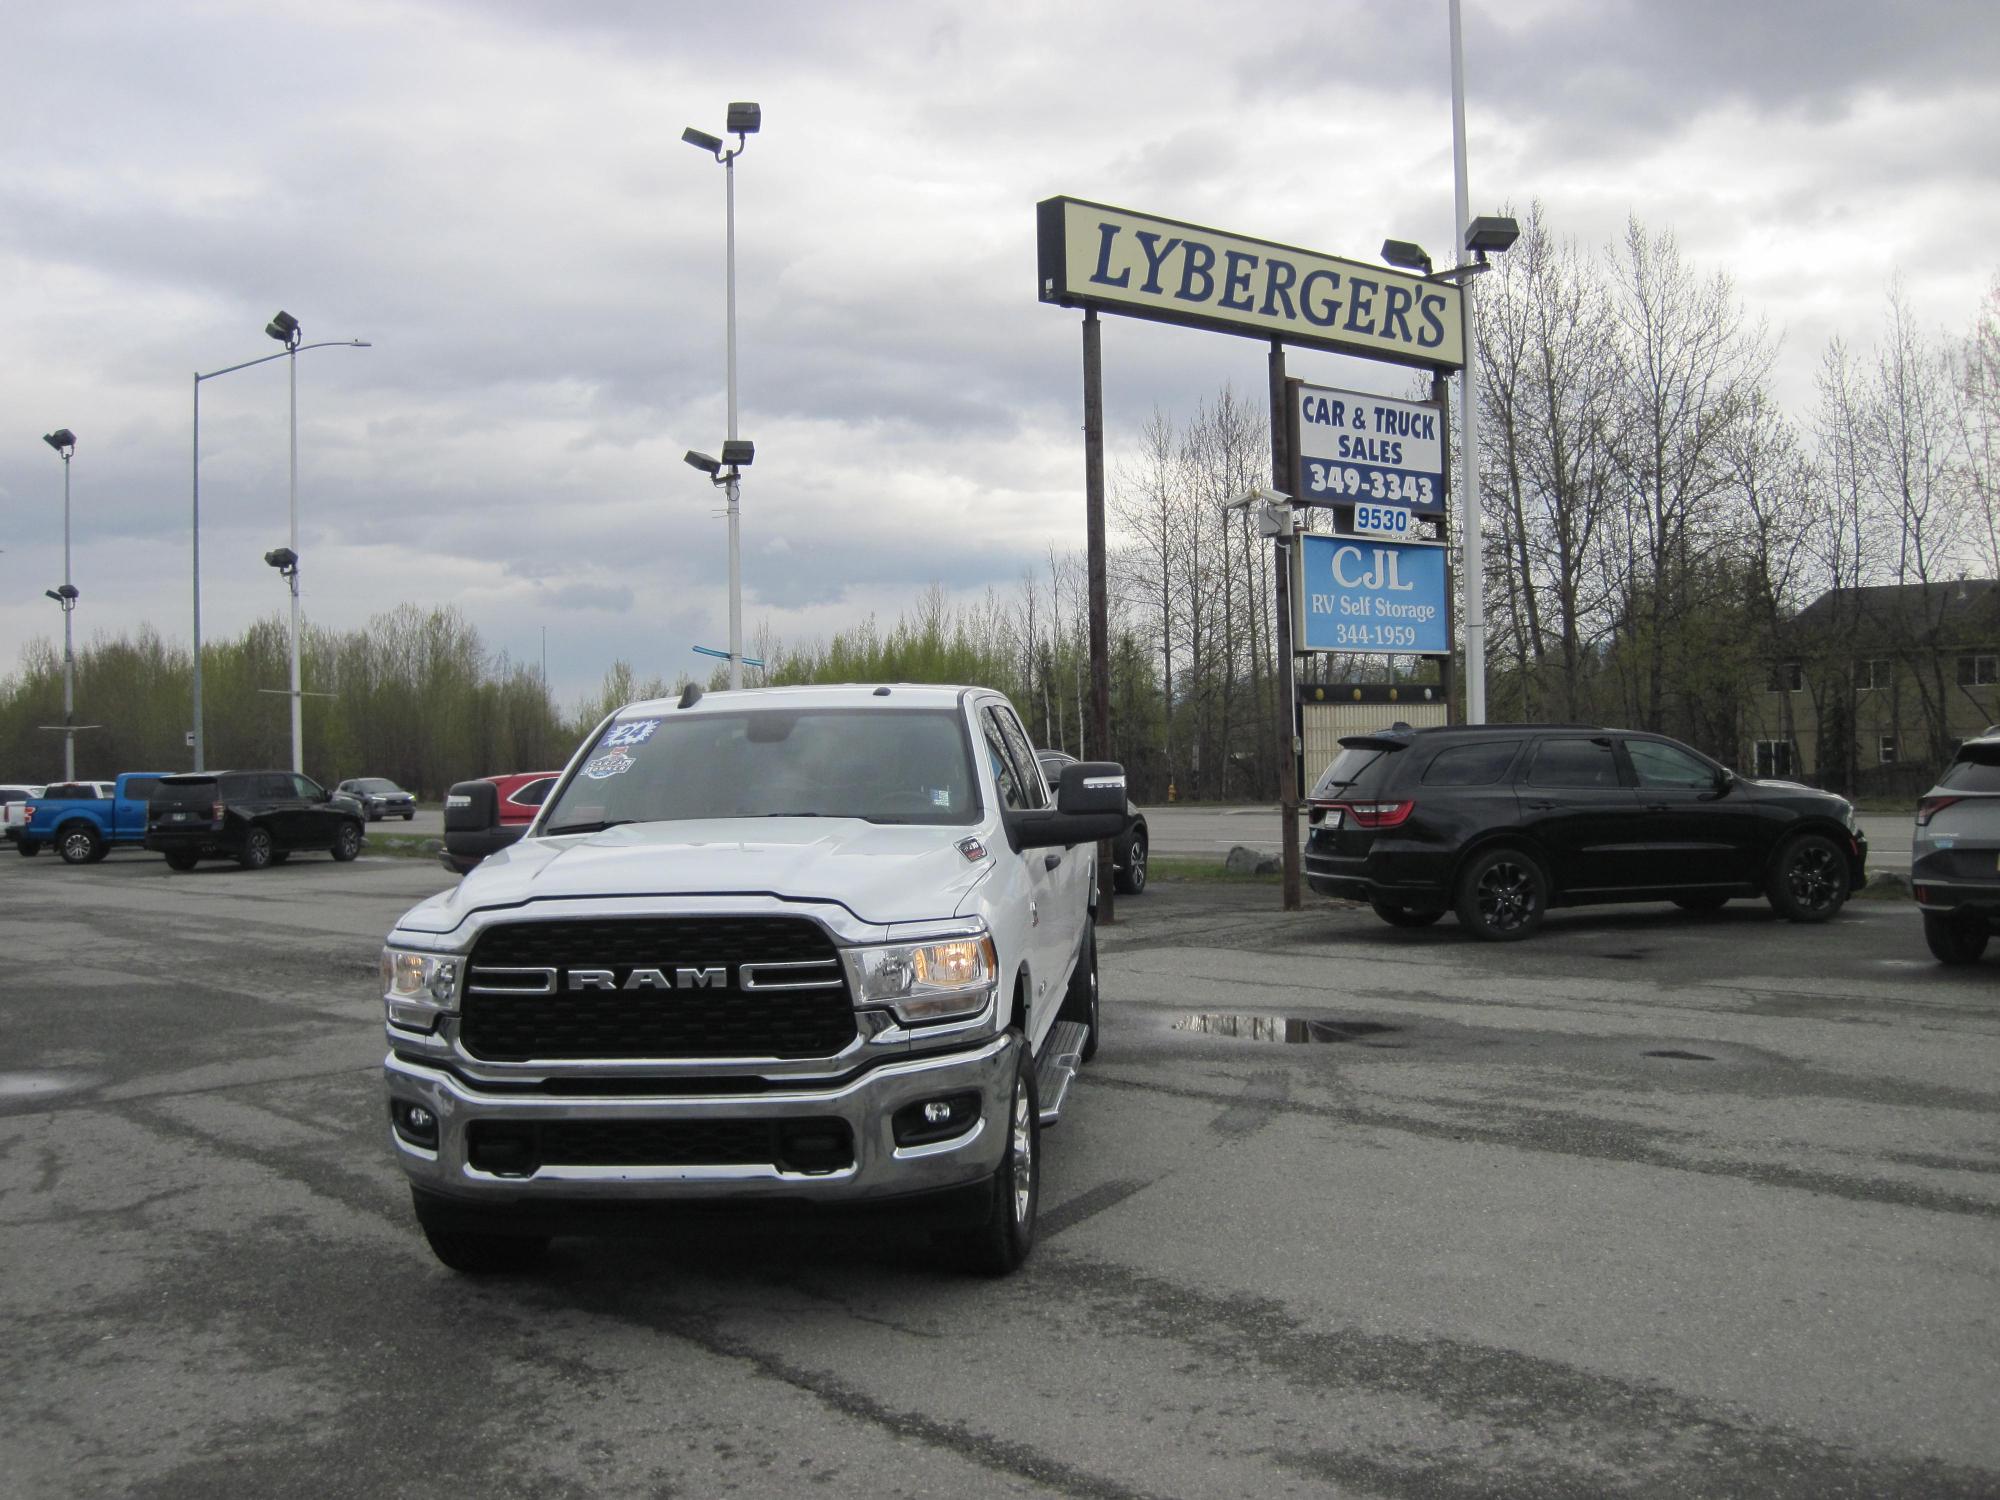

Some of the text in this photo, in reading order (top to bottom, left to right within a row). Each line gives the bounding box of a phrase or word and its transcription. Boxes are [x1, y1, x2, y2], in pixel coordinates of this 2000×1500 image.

[1090, 222, 1446, 348] LYBERGER'S
[1303, 395, 1435, 440] CAR & TRUCK
[1338, 434, 1403, 465] SALES
[1309, 463, 1433, 504] 349-3343
[1358, 507, 1407, 532] 9530
[1331, 546, 1413, 591] CJL
[1312, 594, 1435, 622] RV Self Storage
[1337, 623, 1415, 645] 344-1959
[568, 967, 727, 990] RAM
